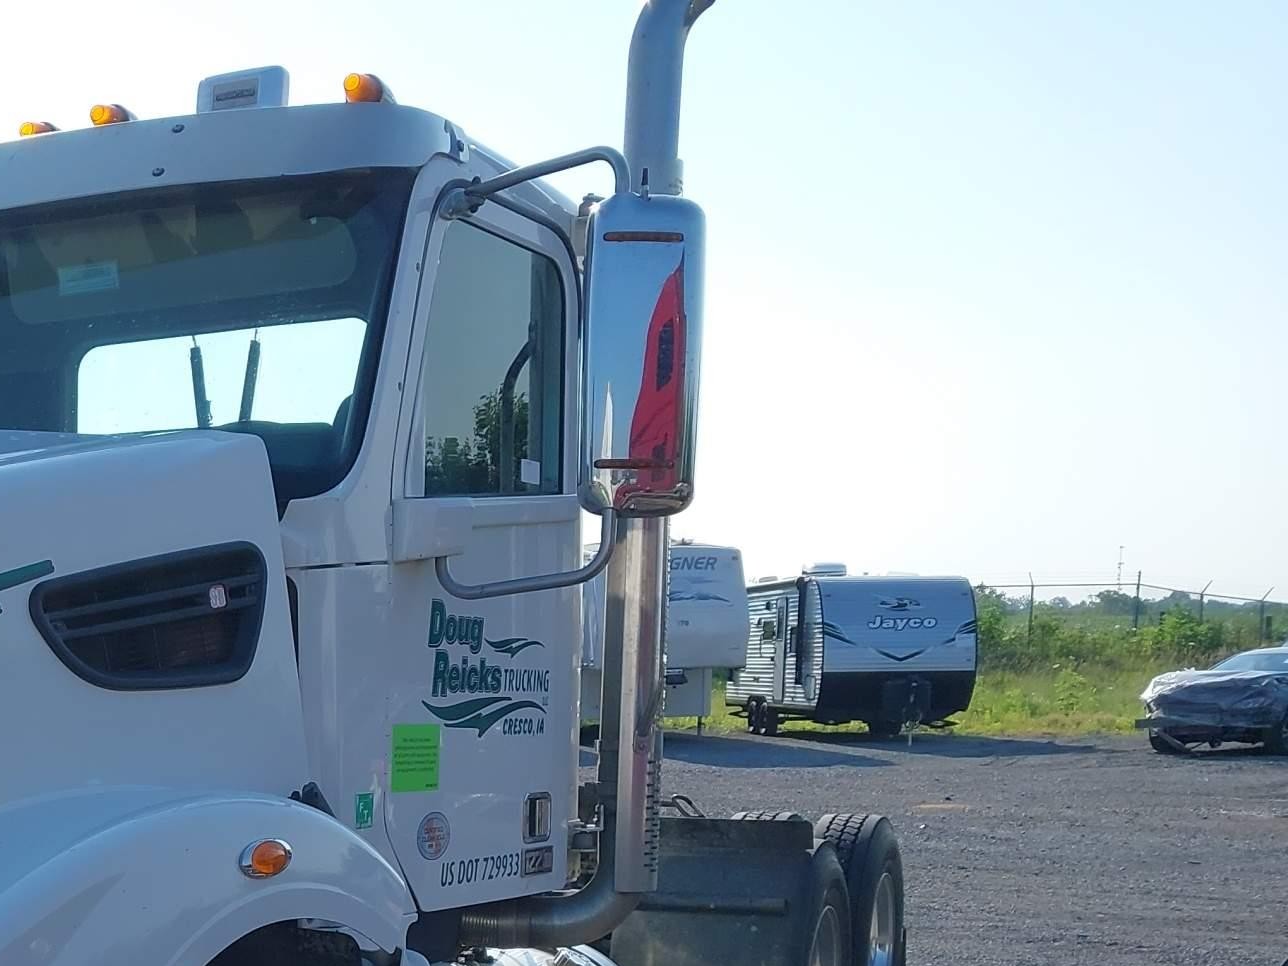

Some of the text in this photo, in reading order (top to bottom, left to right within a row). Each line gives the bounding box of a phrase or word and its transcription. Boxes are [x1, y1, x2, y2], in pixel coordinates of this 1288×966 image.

[428, 599, 485, 654] Doug
[867, 615, 938, 632] Jayco
[432, 650, 550, 697] Reicks TRUCKING
[441, 853, 520, 887] US DOT 729933
